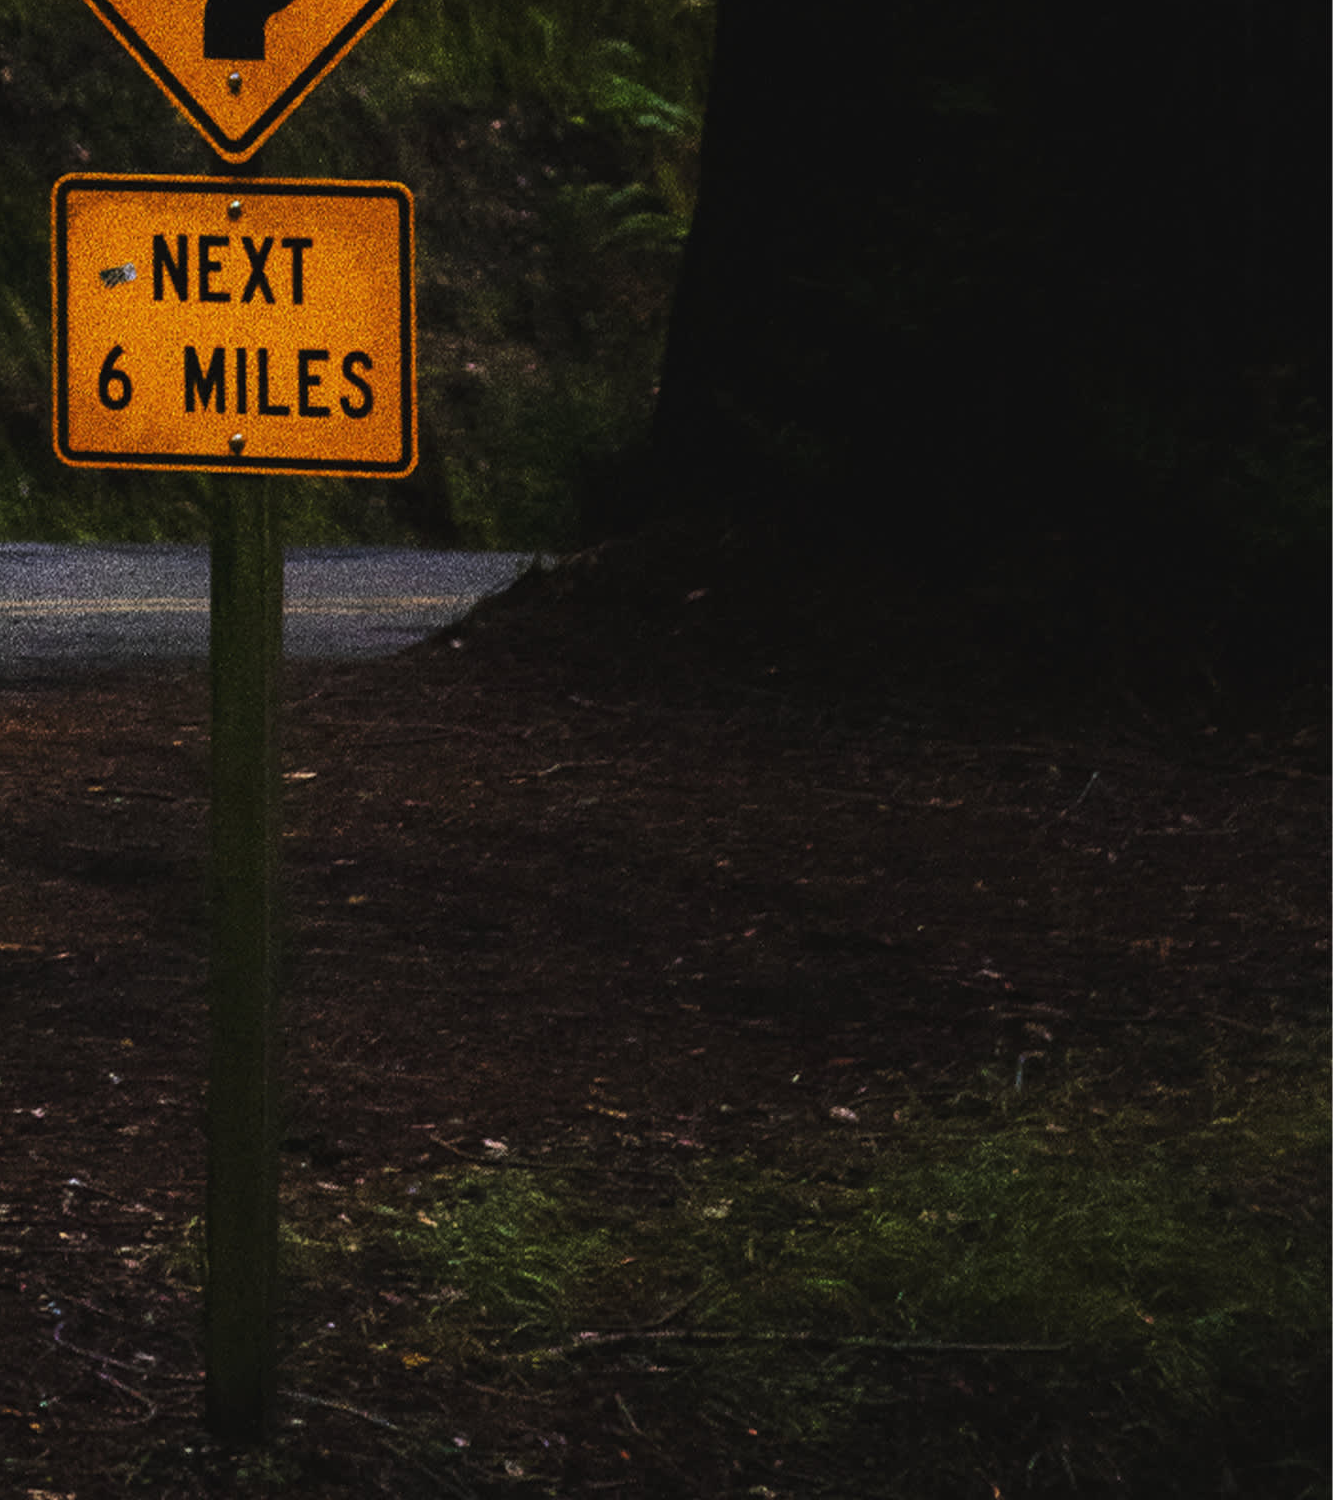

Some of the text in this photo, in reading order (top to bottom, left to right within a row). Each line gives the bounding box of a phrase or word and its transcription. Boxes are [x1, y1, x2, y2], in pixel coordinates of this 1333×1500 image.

[152, 234, 314, 305] NEXT
[97, 345, 374, 419] 6 MILES
